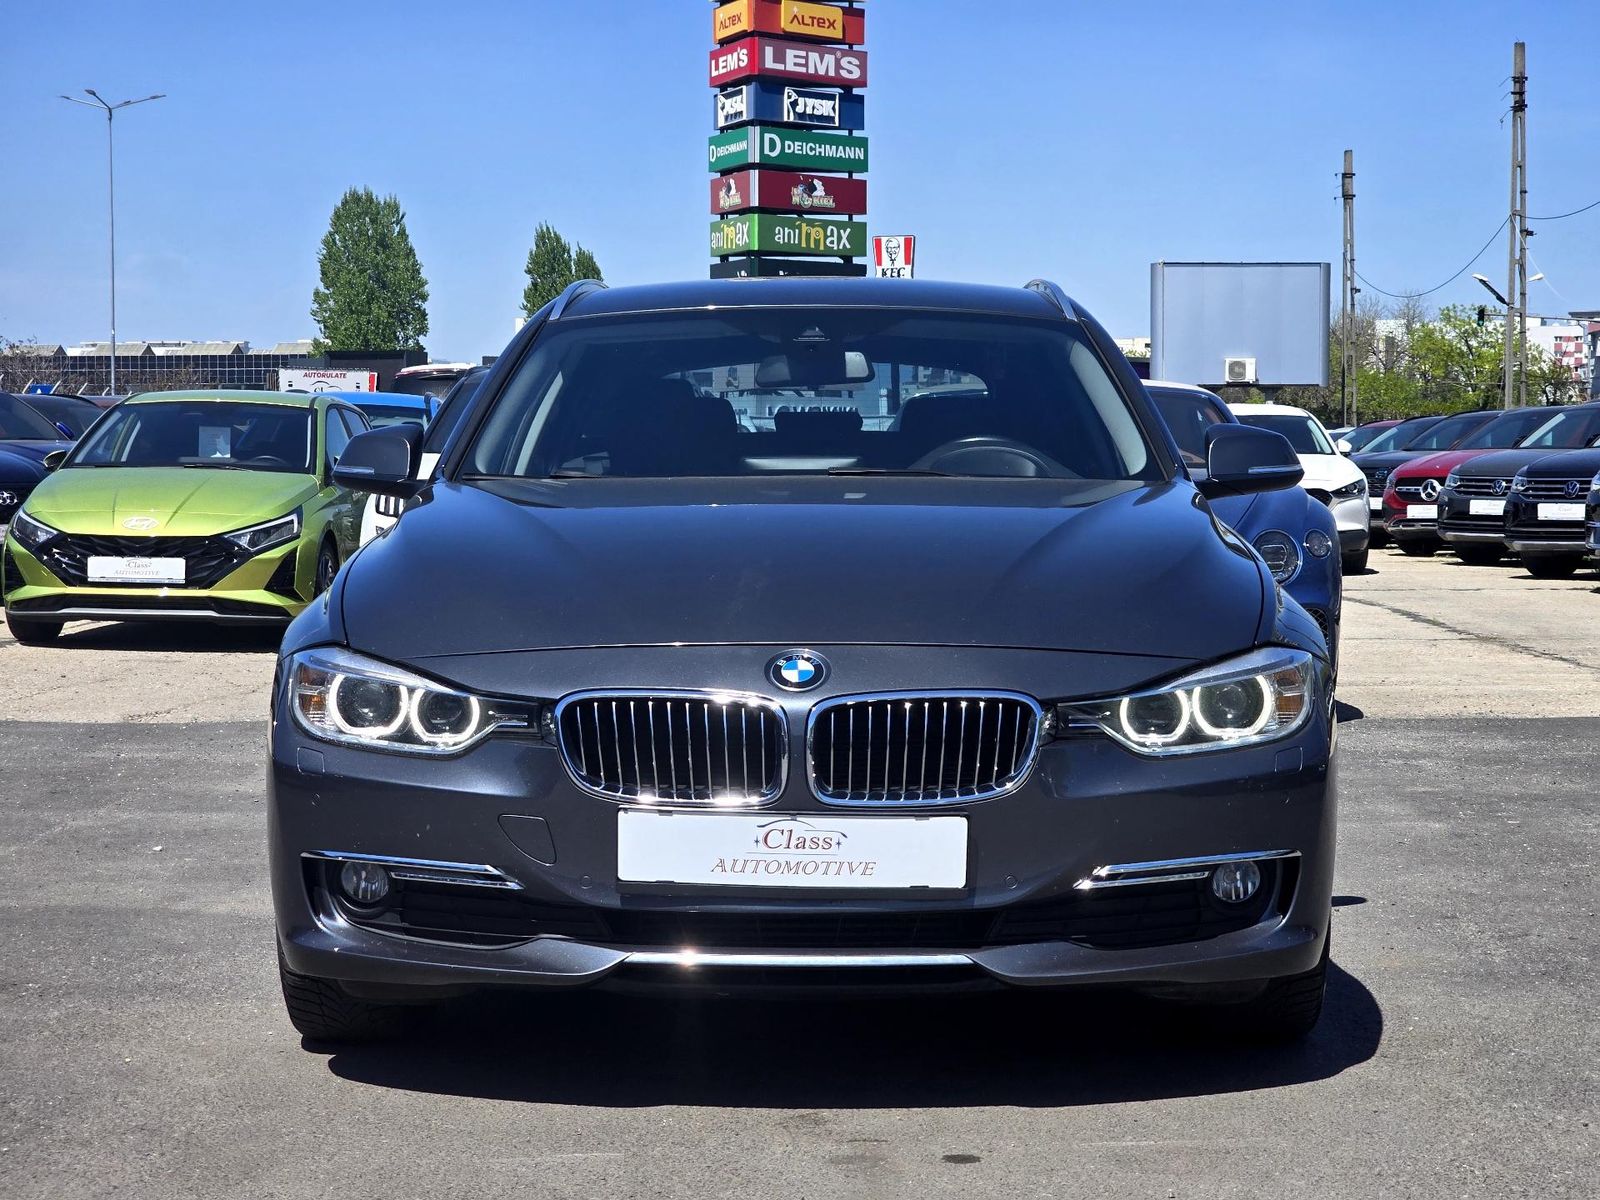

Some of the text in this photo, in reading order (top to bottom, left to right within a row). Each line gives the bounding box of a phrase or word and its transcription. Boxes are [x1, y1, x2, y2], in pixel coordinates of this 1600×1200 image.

[711, 47, 748, 77] LEM'S
[795, 97, 835, 117] JYSK
[716, 139, 747, 156] DEICHMANN
[784, 140, 864, 160] DEICHMANN
[711, 221, 749, 249] animax
[774, 221, 851, 250] animax
[763, 828, 833, 850] Class
[710, 857, 876, 877] AUTOMOTIVE
